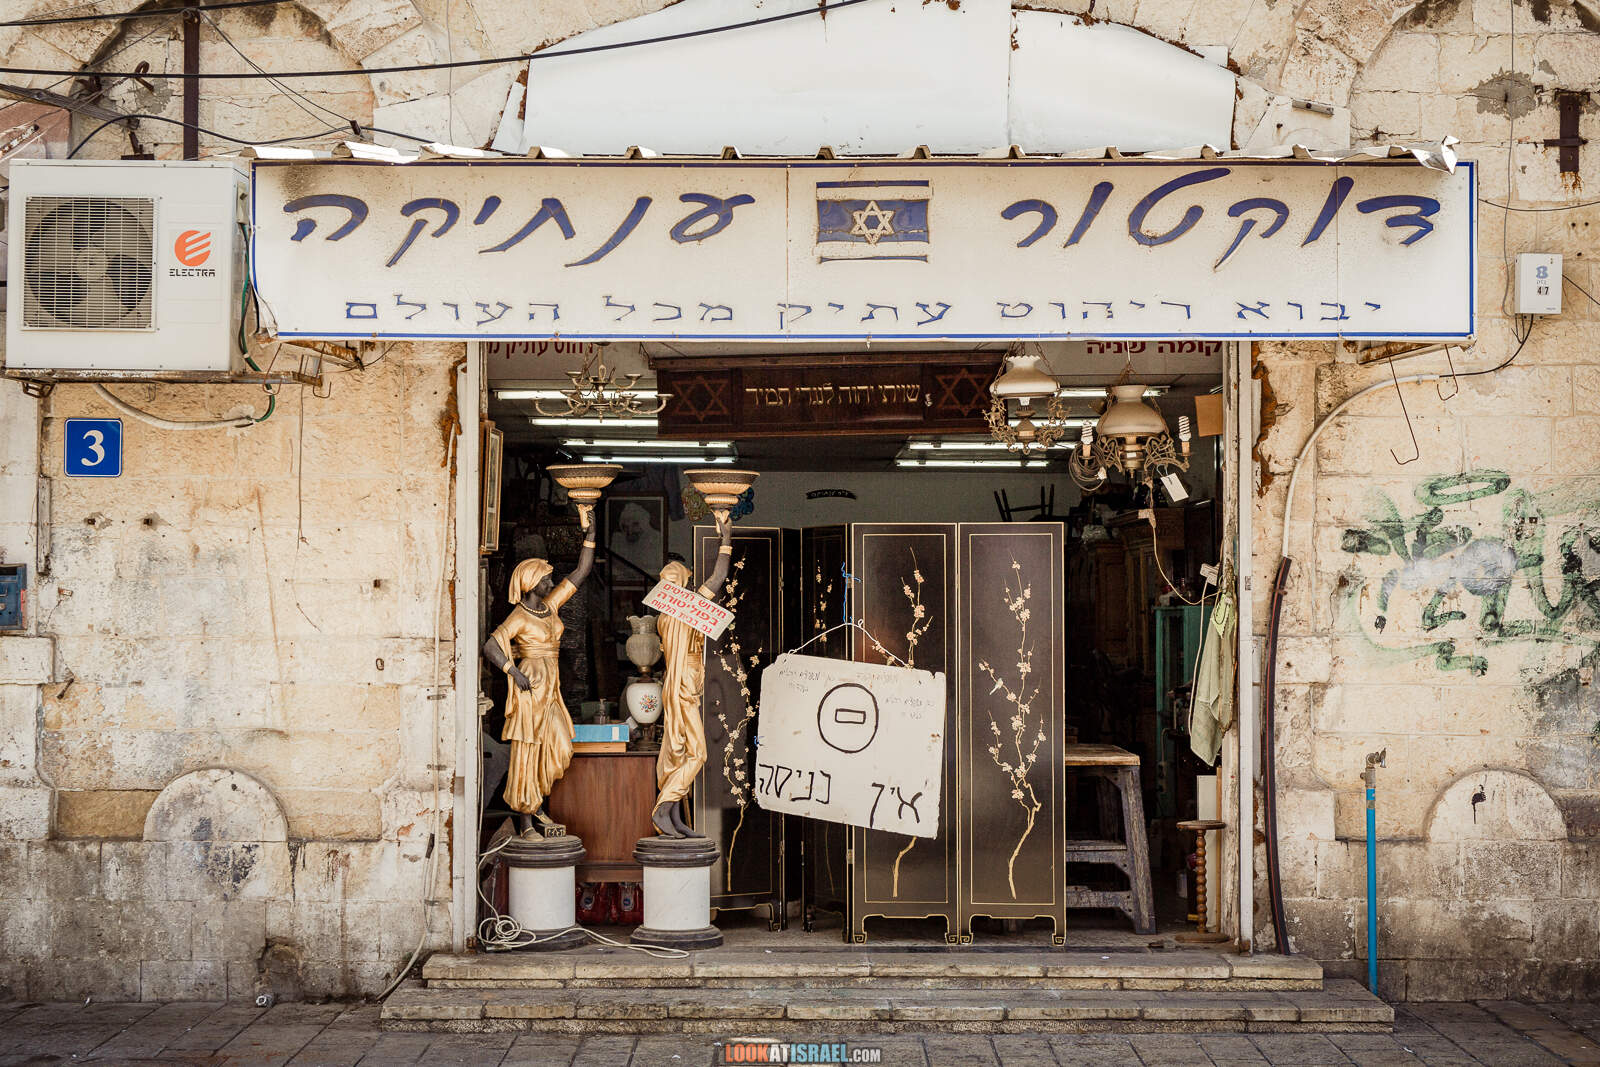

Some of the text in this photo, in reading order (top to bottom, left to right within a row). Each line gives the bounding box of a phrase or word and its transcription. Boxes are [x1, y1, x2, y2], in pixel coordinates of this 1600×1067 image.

[282, 167, 1441, 272] דוקטור ענתיקה
[168, 268, 216, 277] ELECTRA
[1535, 265, 1549, 279] 8
[1537, 286, 1549, 295] 47
[345, 294, 1382, 330] יבוא ריהוט עתיק מכל העולם
[1086, 340, 1223, 357] קומה שניה
[744, 387, 792, 408] תמיד
[81, 429, 106, 467] 3
[698, 599, 728, 620] חידוש
[758, 763, 923, 829] אין כניסה
